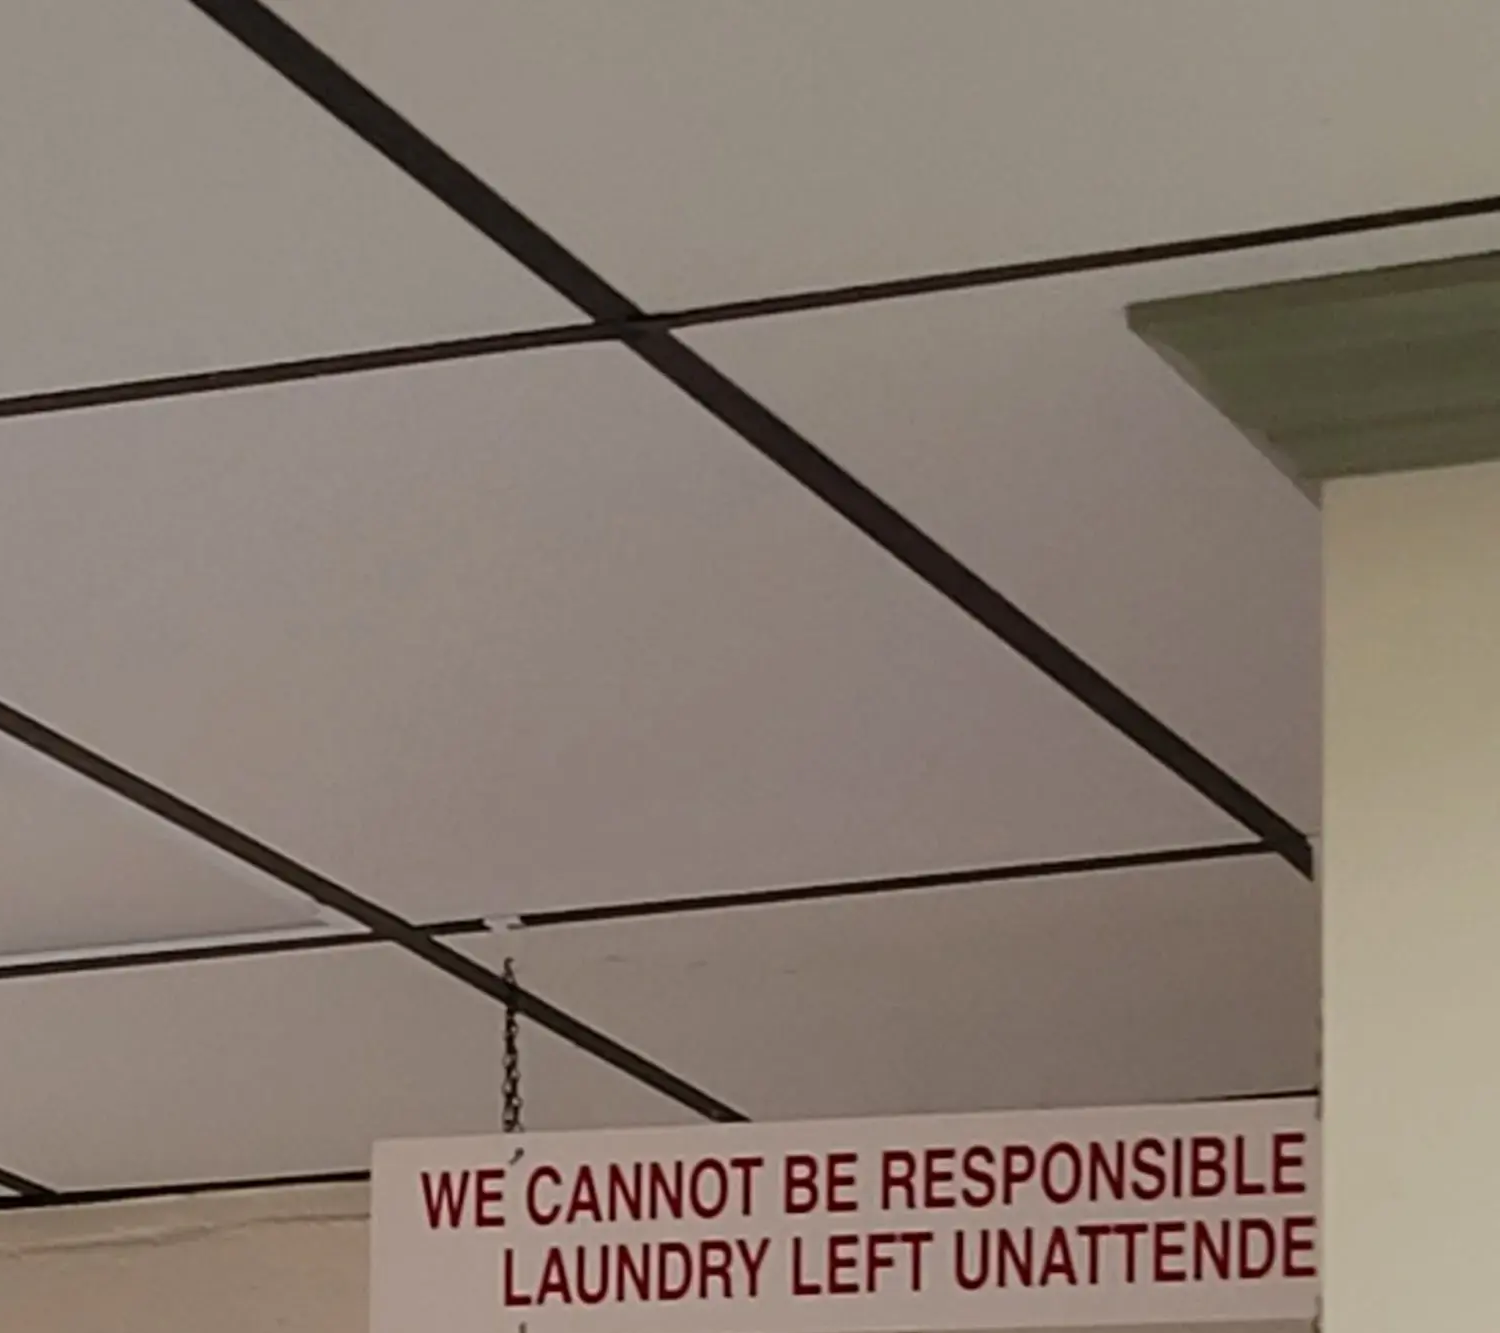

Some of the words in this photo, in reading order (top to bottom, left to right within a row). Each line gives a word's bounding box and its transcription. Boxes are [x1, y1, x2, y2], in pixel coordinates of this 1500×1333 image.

[418, 1169, 506, 1230] WE
[525, 1155, 766, 1228] CANNOT
[781, 1150, 860, 1218] BE
[879, 1131, 1308, 1213] RESPONSIBLE
[501, 1236, 772, 1309] LAUNDRY
[788, 1229, 937, 1300] LEFT
